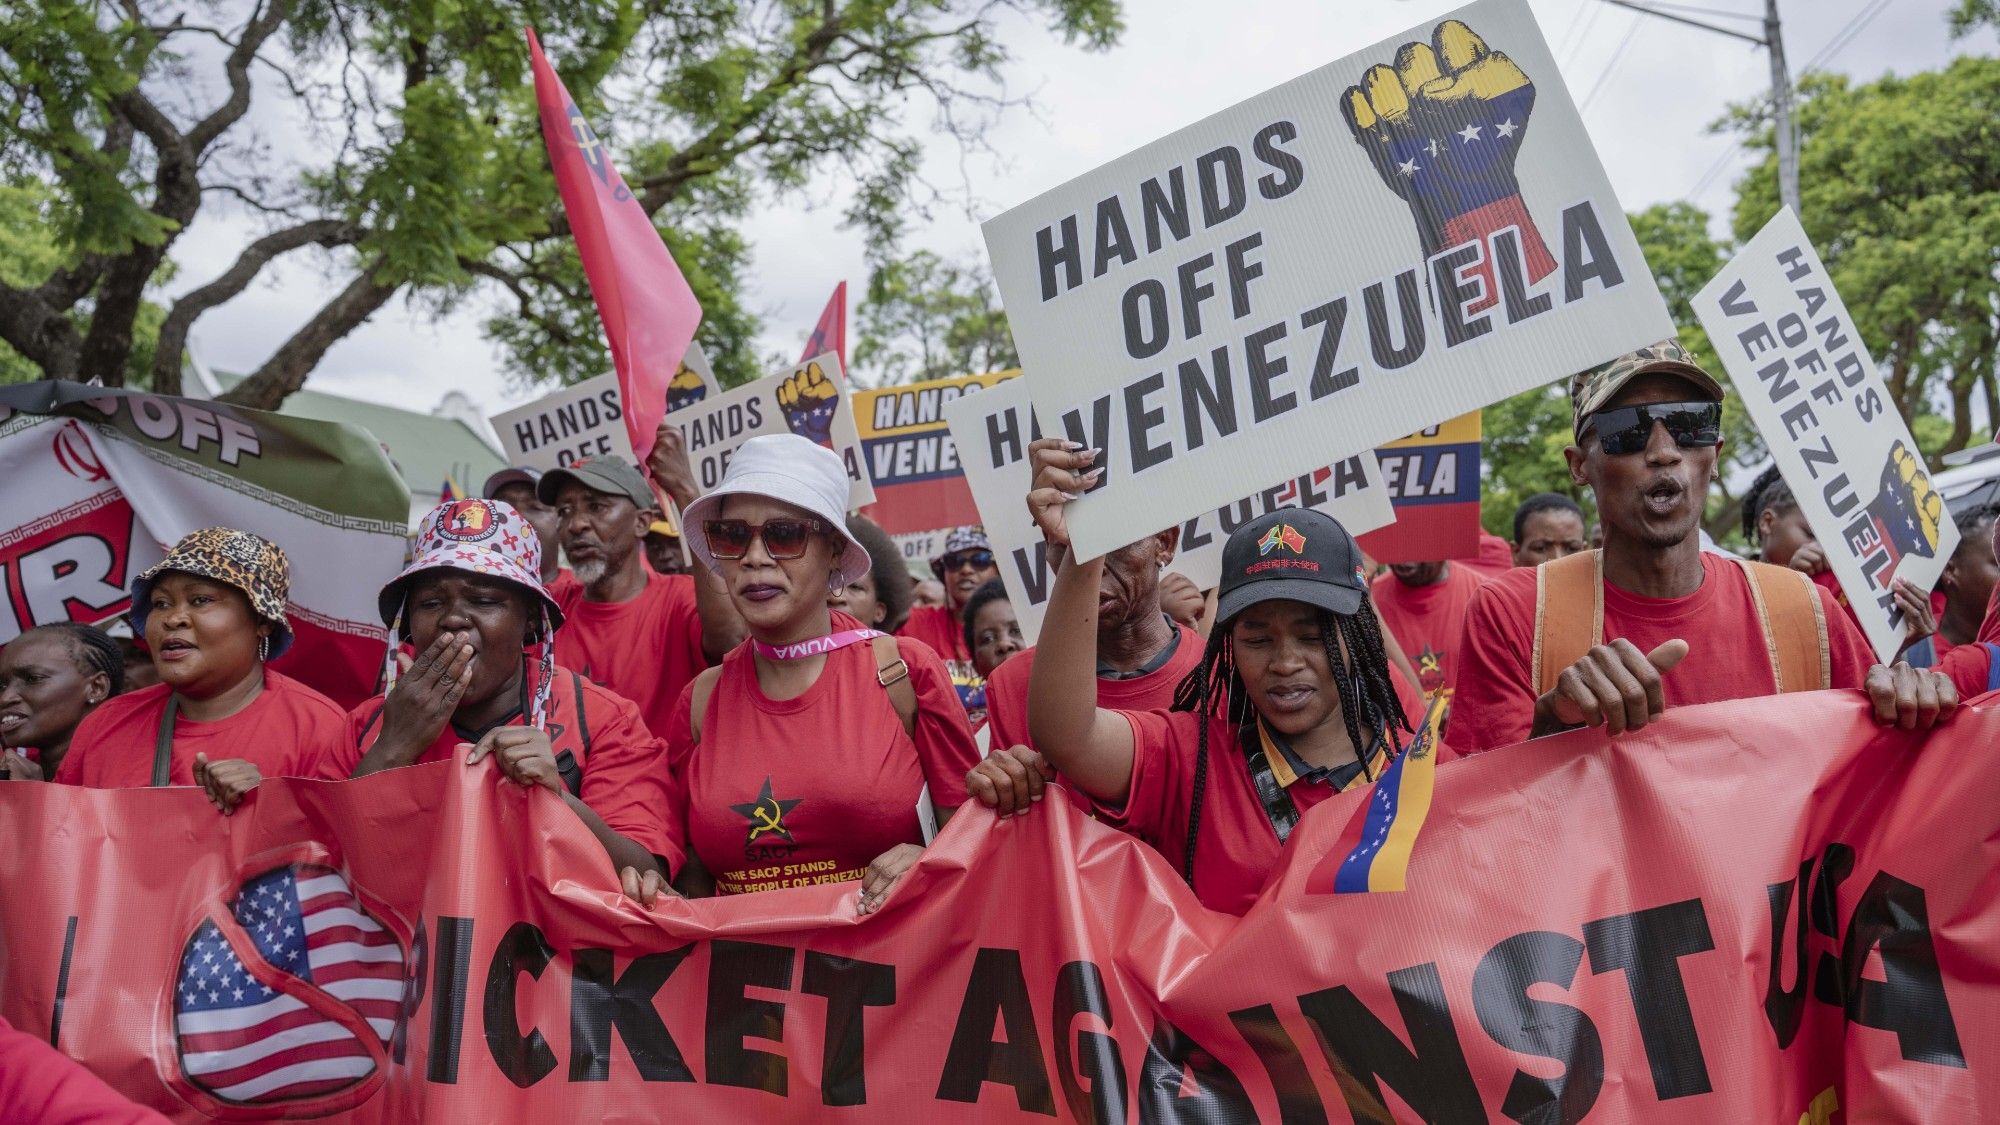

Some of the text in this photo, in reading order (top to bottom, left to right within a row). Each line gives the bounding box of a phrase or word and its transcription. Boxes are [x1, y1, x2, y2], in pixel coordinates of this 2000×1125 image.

[1036, 120, 1303, 302] HANDS
[1121, 232, 1264, 359] OFF
[1062, 200, 1625, 495] VENEZUELA
[1776, 246, 1883, 423] HANDS
[1777, 312, 1843, 407] OFF
[127, 396, 262, 468] OFF
[515, 389, 622, 453] HANDS
[873, 382, 984, 431] HAND
[701, 445, 742, 489] OF
[1718, 279, 1903, 631] VENEZUELA
[459, 525, 497, 542] WORKERS
[905, 539, 933, 557] OFF
[773, 638, 837, 660] VUMA
[724, 860, 837, 881] THE SACP STANDS
[744, 843, 800, 863] SACP
[812, 867, 869, 886] VENEZU
